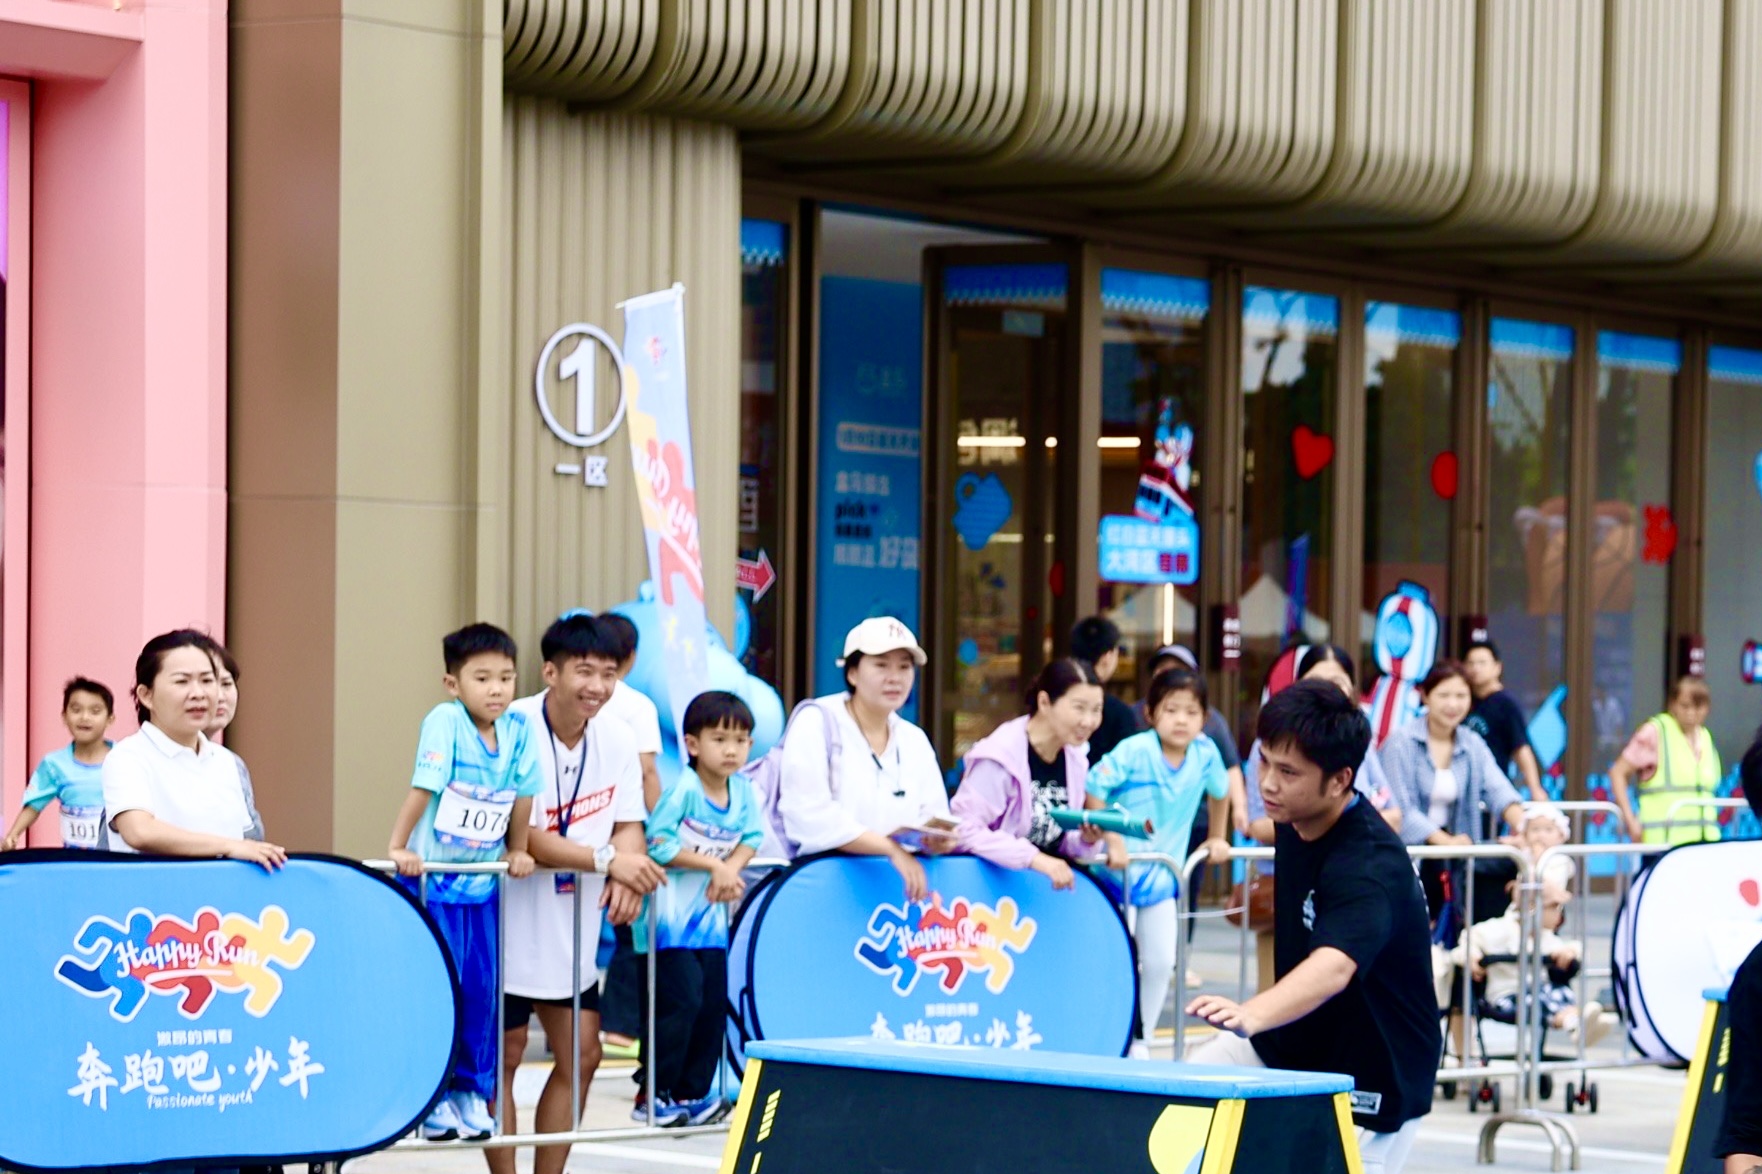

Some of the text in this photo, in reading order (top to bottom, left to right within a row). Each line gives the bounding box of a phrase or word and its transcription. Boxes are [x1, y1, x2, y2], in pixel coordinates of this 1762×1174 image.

[554, 455, 608, 487] 一区
[113, 929, 261, 978] Happy Run
[896, 917, 999, 958] Happy Run
[146, 1088, 254, 1113] Passionate youth
